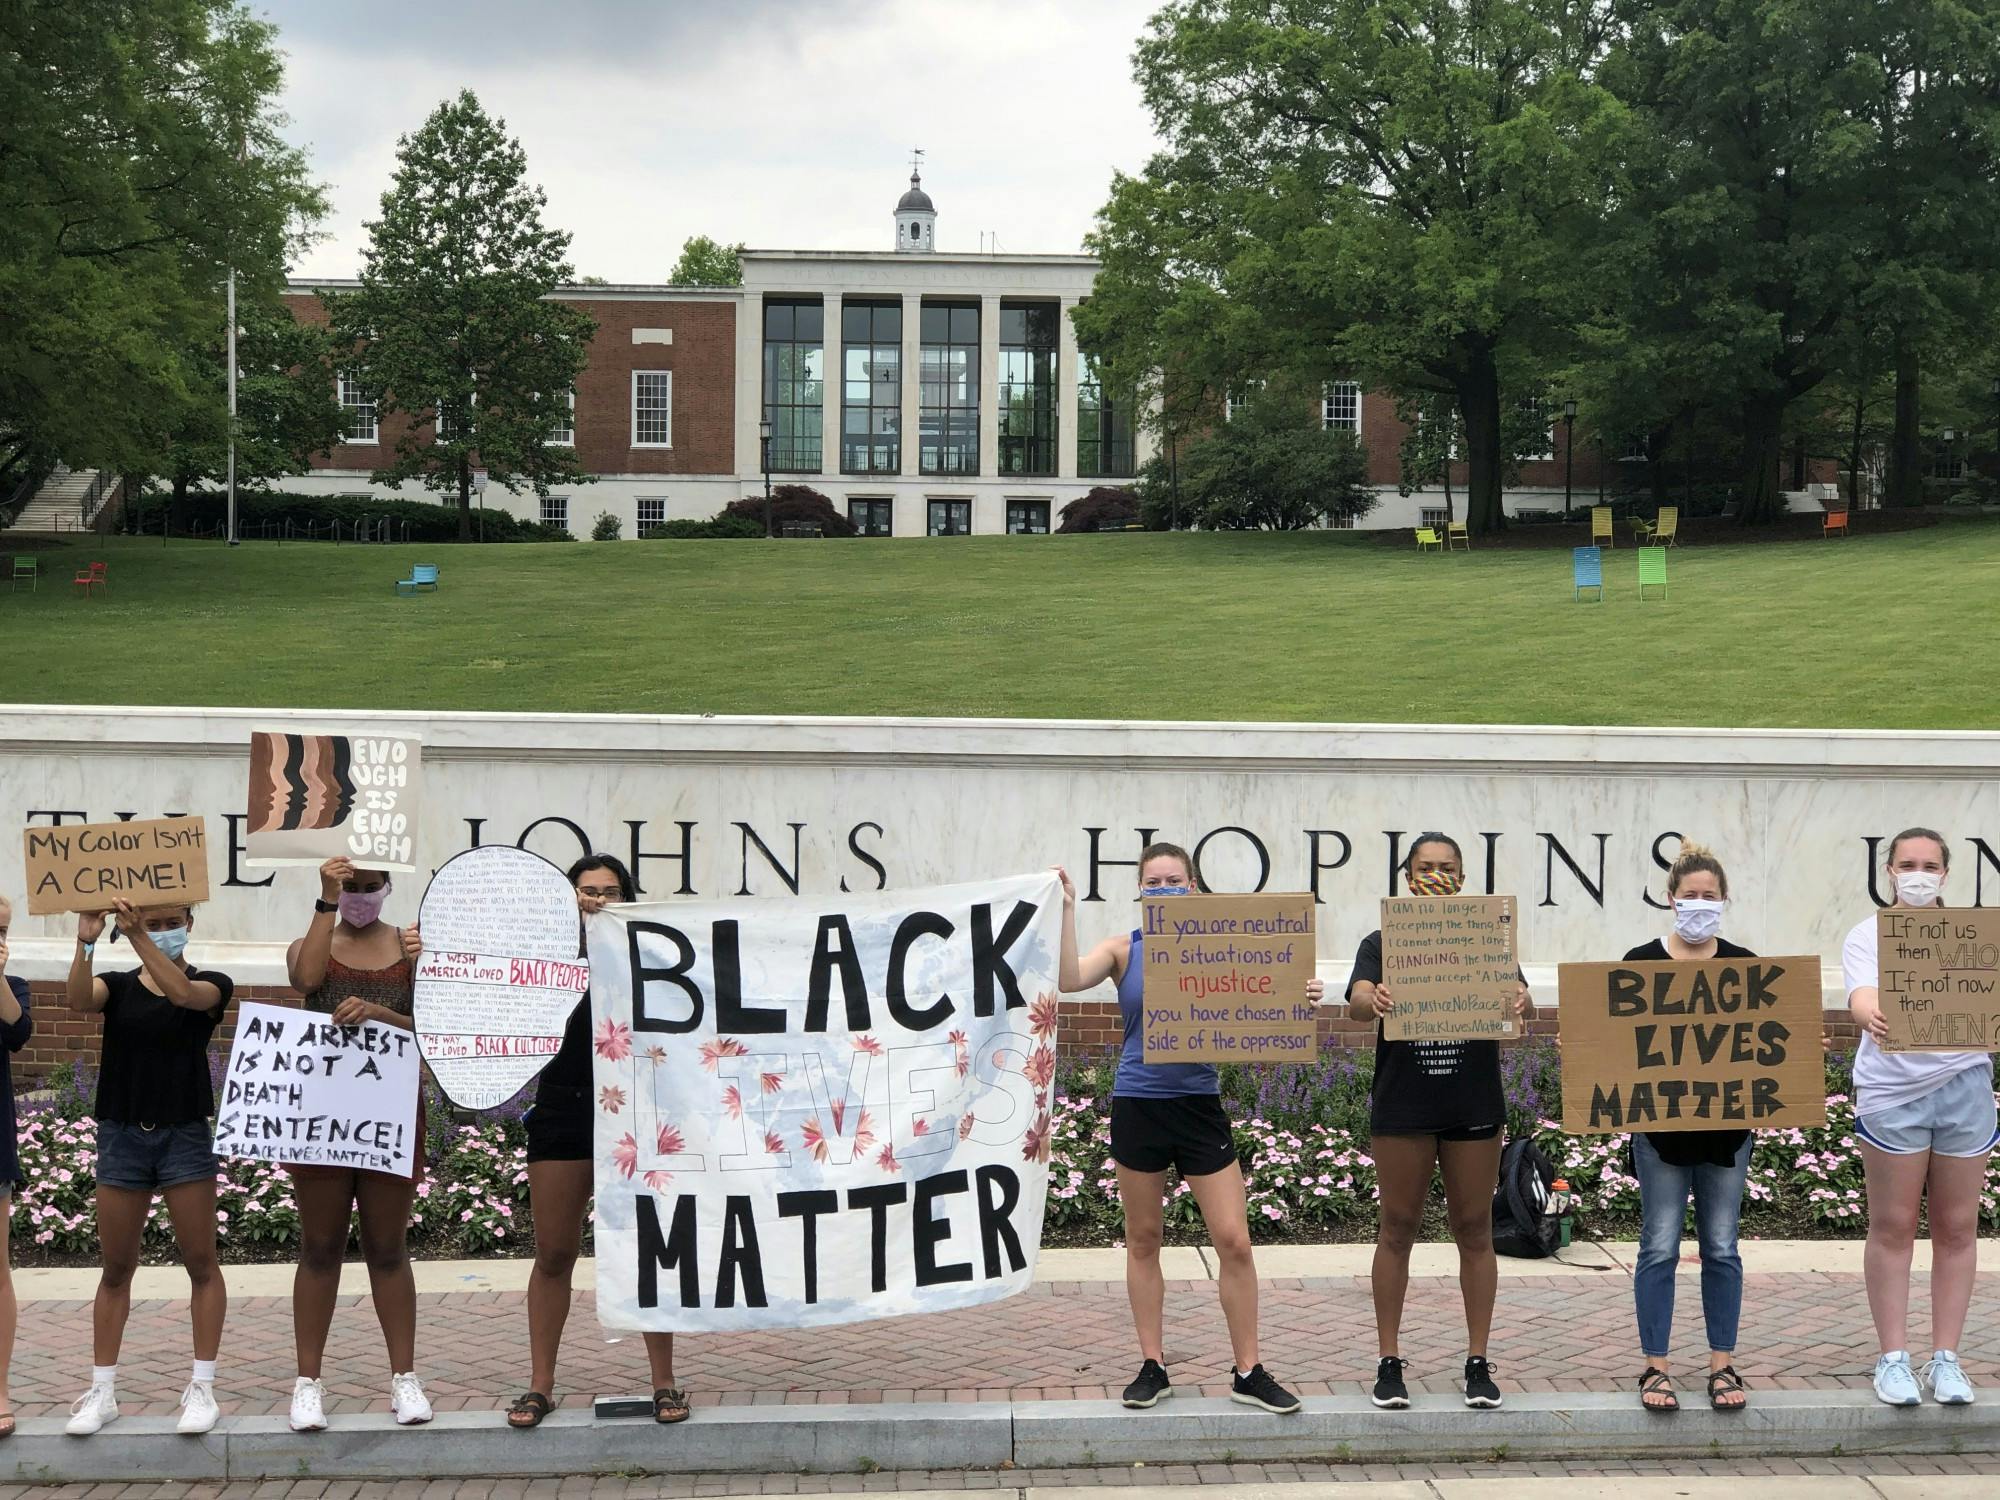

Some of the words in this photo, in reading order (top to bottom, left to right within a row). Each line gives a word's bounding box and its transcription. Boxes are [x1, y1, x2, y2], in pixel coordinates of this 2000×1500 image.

[354, 739, 407, 764] ENO
[352, 765, 407, 787] UGH
[365, 790, 397, 810] IS
[353, 809, 407, 834] ENO
[29, 832, 70, 861] My
[79, 830, 144, 852] Color
[154, 825, 203, 849] Isn't
[348, 834, 411, 863] UGH
[36, 871, 63, 895] A
[73, 862, 187, 893] CRIME!
[1419, 904, 1435, 914] no
[1443, 902, 1488, 915] longer
[1146, 905, 1165, 935] If
[1174, 919, 1207, 944] you
[1211, 919, 1237, 934] are
[1244, 911, 1309, 934] neutral
[1447, 919, 1463, 929] the
[1468, 919, 1501, 931] things
[1883, 915, 1916, 939] If
[1920, 917, 1949, 939] not
[1955, 924, 1977, 939] us
[1152, 948, 1170, 964] in
[1180, 944, 1272, 964] situations
[1277, 943, 1294, 963] of
[1396, 937, 1431, 948] cannot
[1436, 935, 1475, 947] change
[433, 953, 440, 963] I
[446, 953, 476, 966] WISH
[626, 900, 1038, 1034] BLACK
[1387, 952, 1460, 970] CHANGING
[1464, 954, 1480, 966] the
[1483, 953, 1513, 965] things
[1896, 943, 1930, 959] then
[1935, 943, 1999, 968] WHO
[420, 966, 469, 978] AMERICA
[474, 968, 503, 981] LOVED
[510, 958, 547, 986] BLACK
[550, 963, 590, 991] PEOPLE
[1179, 969, 1277, 998] injustice,
[1396, 974, 1432, 985] cannot
[1435, 972, 1472, 985] accept
[1885, 971, 1917, 993] If
[1922, 973, 1951, 993] not
[1958, 978, 1995, 993] now
[1608, 964, 1785, 1017] BLACK
[1148, 1009, 1182, 1028] you
[1190, 1003, 1228, 1021] have
[1235, 1004, 1286, 1021] chosen
[1292, 1004, 1315, 1021] the
[1899, 996, 1934, 1012] then
[243, 1016, 285, 1044] AN
[297, 1022, 410, 1057] ARREST
[422, 1035, 438, 1044] THE
[442, 1035, 460, 1044] WAY
[427, 1046, 438, 1056] IT
[443, 1046, 467, 1056] LOVED
[475, 1036, 509, 1056] BLACK
[514, 1037, 560, 1055] CULTURE
[1147, 1031, 1178, 1050] side
[1188, 1029, 1206, 1050] of
[1212, 1031, 1237, 1050] the
[1241, 1034, 1311, 1054] oppressor
[1635, 1021, 1791, 1069] LIVES
[235, 1050, 262, 1074] IS
[272, 1051, 343, 1076] NOT
[355, 1056, 382, 1080] A
[227, 1080, 303, 1110] DEATH
[634, 1032, 1036, 1173] LIVES
[1588, 1077, 1787, 1128] MATTER
[216, 1111, 407, 1159] SENTENCE!
[635, 1164, 1028, 1308] MATTER
